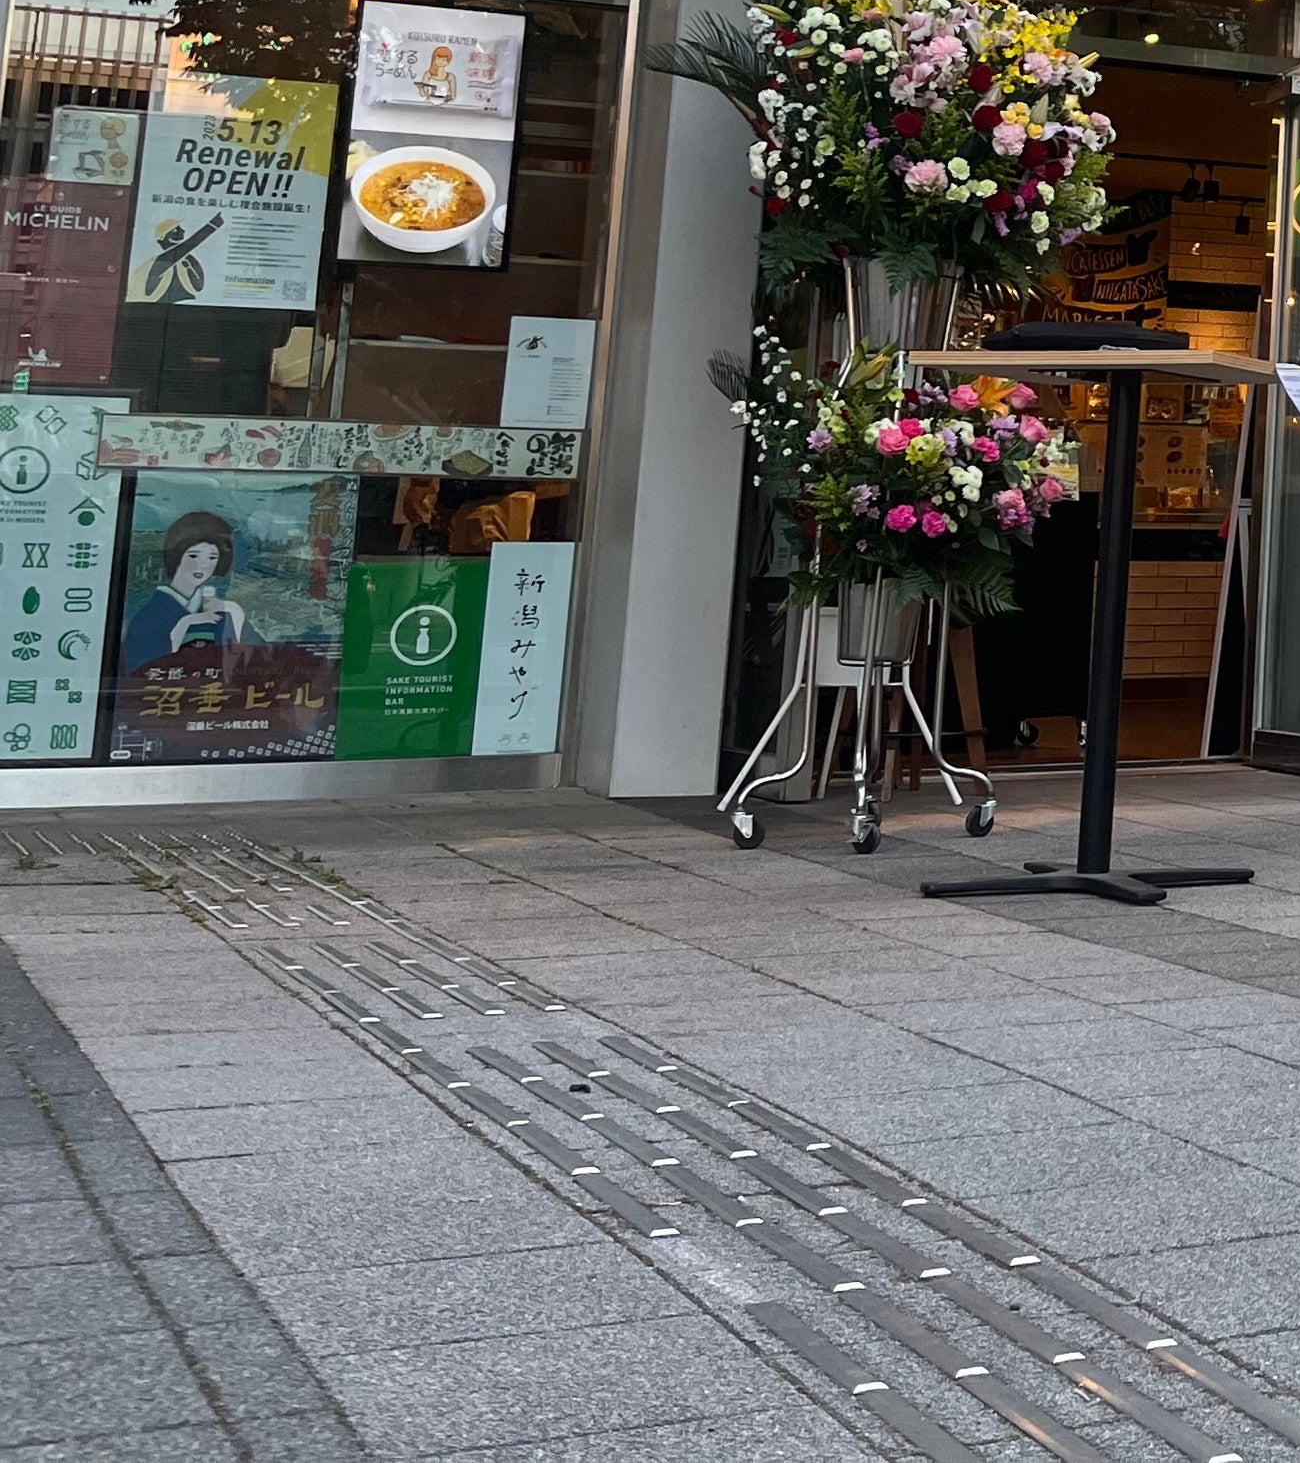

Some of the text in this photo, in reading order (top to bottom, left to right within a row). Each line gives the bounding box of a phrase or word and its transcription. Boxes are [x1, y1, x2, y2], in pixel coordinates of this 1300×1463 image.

[202, 114, 216, 141] 2023
[217, 117, 282, 146] 5.13
[175, 138, 306, 171] Renewal
[182, 167, 294, 198] OPEN!!
[34, 204, 82, 214] LE GUIDE
[4, 211, 109, 231] MICHELIN
[1065, 247, 1125, 273] ICATESSEN
[385, 685, 453, 695] INFORMATION
[386, 674, 453, 685] SAKE TOURIST
[384, 697, 404, 706] BAR
